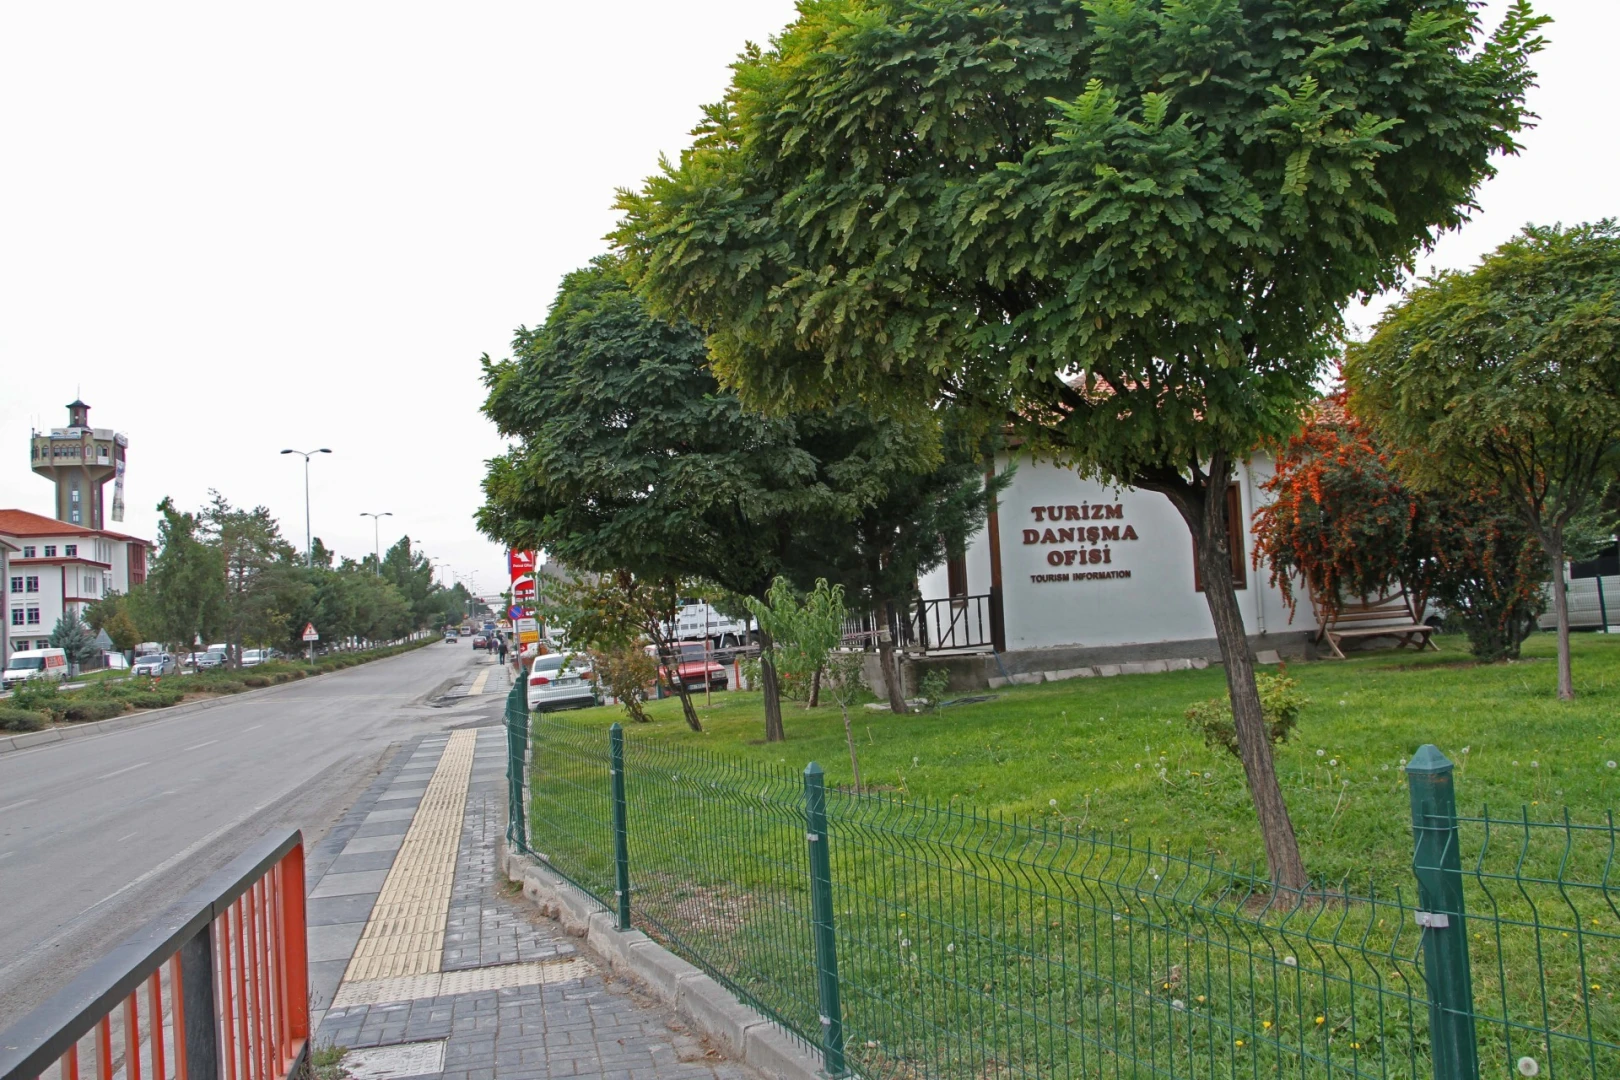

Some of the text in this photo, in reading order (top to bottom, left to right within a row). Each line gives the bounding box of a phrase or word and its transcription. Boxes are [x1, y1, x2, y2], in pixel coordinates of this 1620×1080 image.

[1031, 500, 1124, 522] TURİZM
[1022, 525, 1139, 546] DANIŞMA
[1047, 544, 1112, 567] OFİSİ
[1030, 570, 1132, 583] TOURISM INFORMATION
